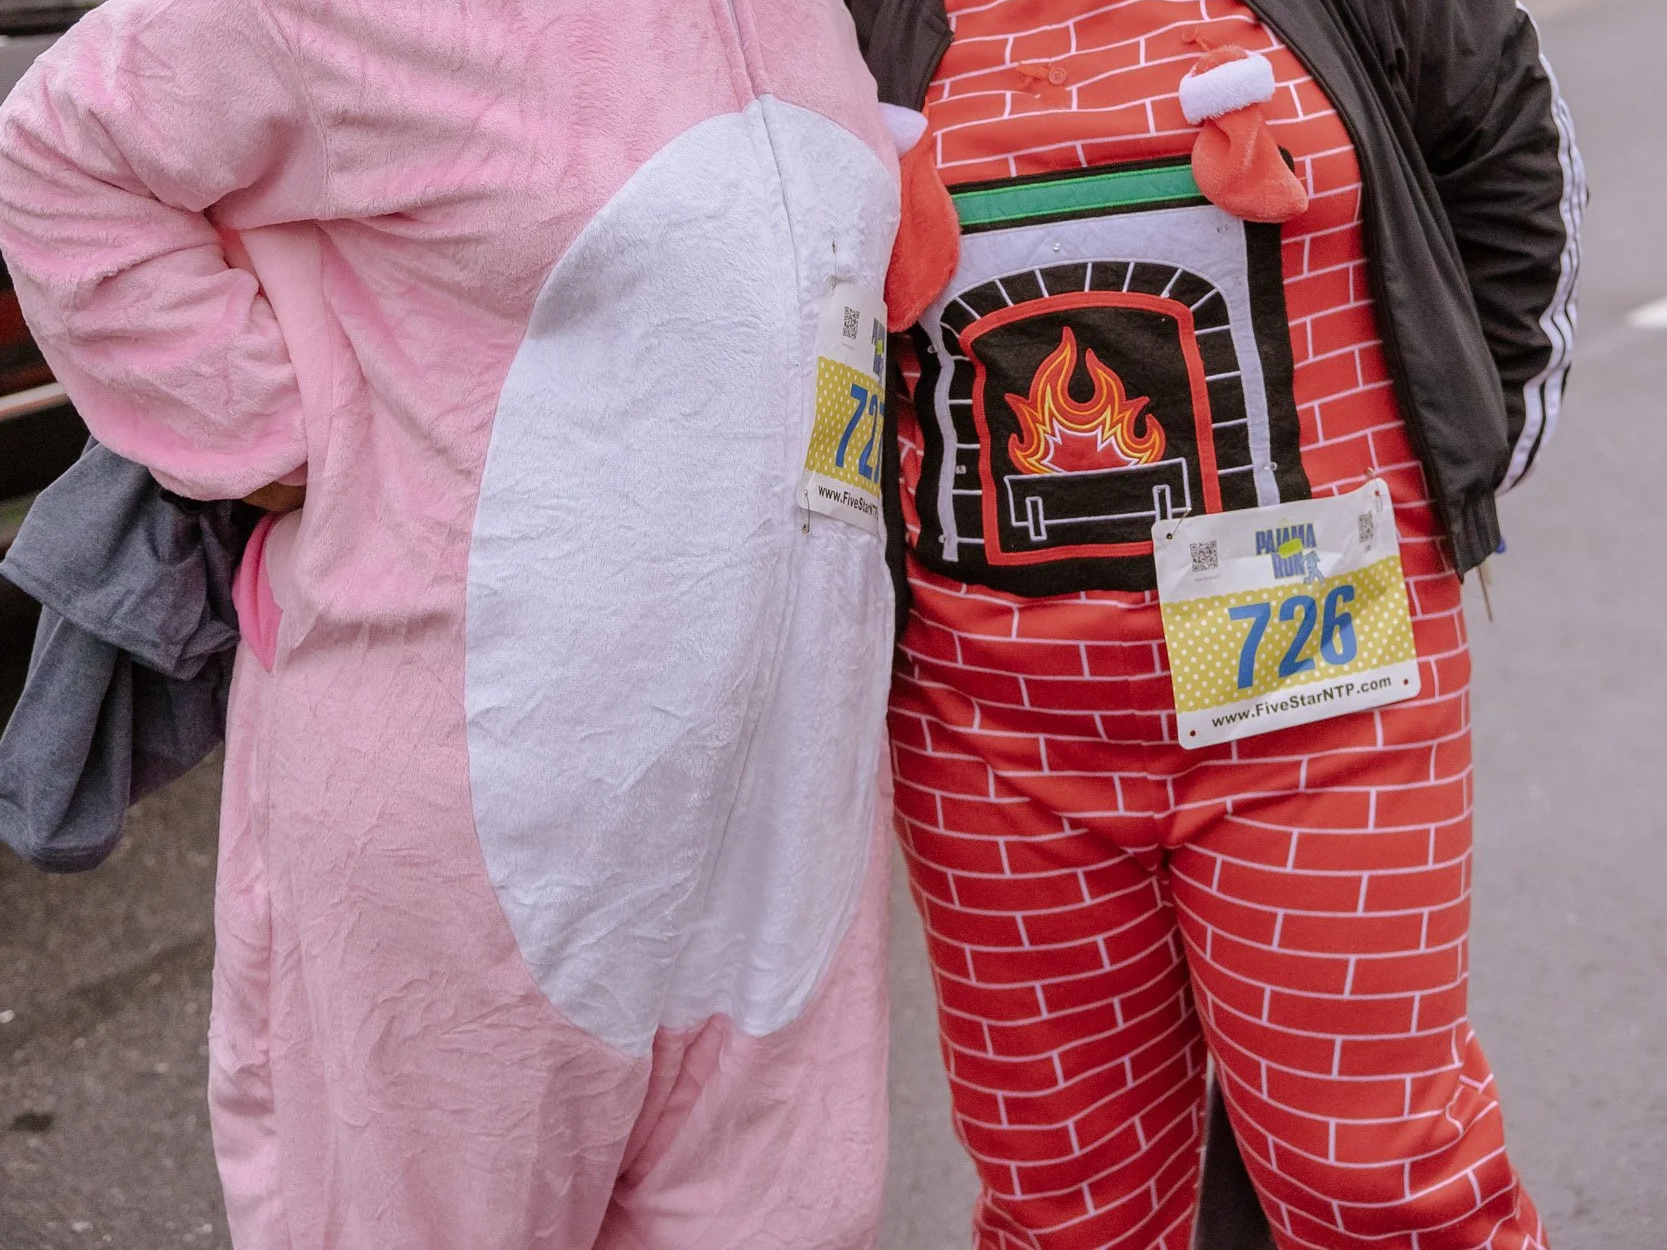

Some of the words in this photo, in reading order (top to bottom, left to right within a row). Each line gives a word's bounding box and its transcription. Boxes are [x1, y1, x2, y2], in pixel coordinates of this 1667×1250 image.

[1255, 523, 1317, 556] PAJAMA
[1271, 552, 1306, 580] RUN
[1228, 585, 1358, 690] 726
[1212, 675, 1392, 728] www.FiveStarNTP.com
